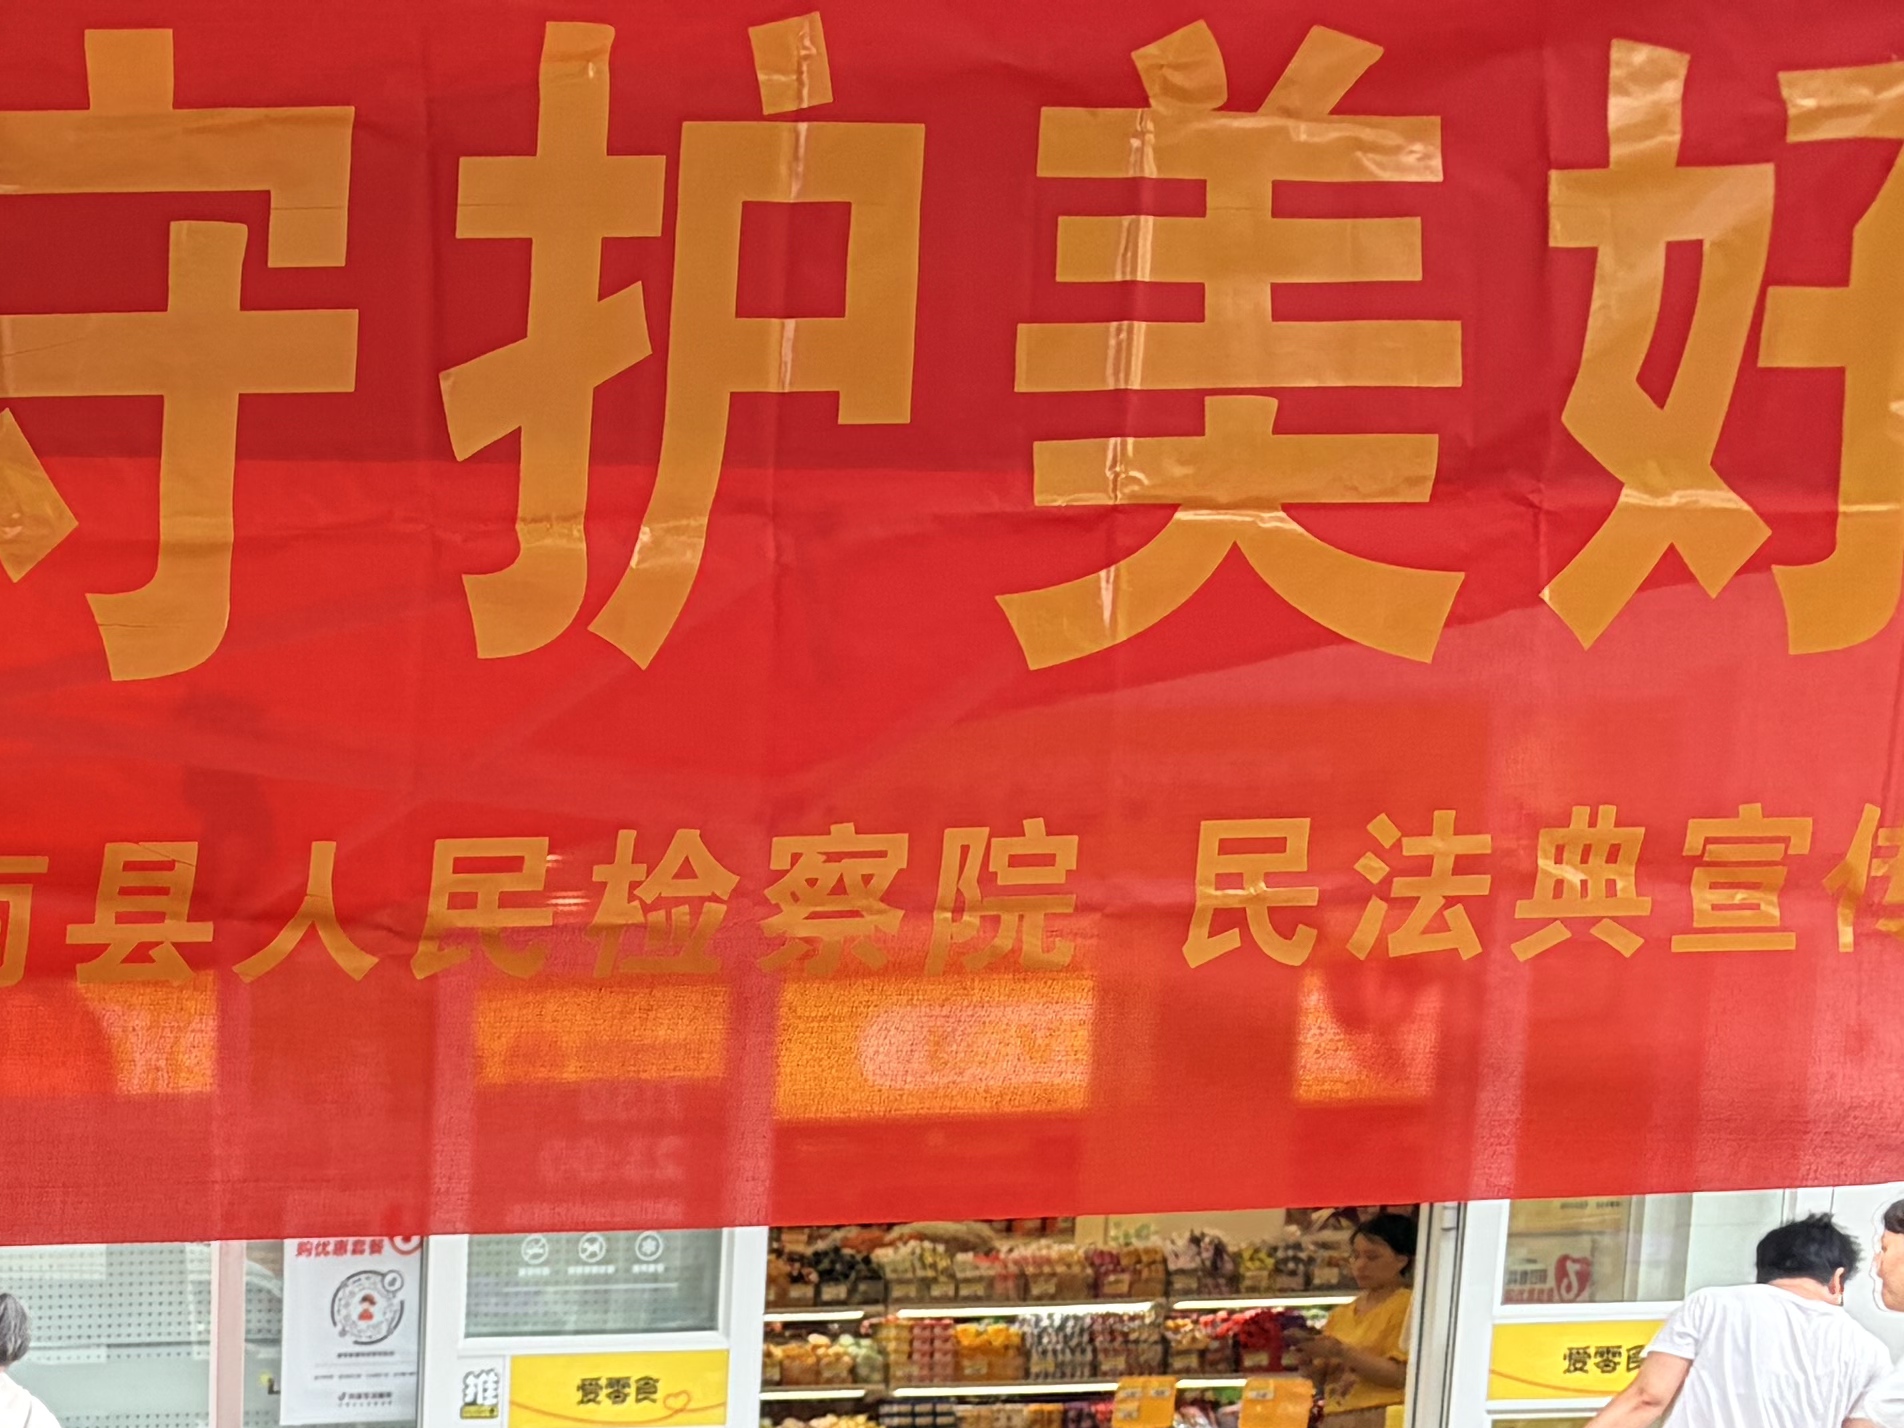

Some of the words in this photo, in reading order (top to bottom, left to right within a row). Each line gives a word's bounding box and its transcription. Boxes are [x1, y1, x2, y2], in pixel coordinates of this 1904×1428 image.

[296, 1239, 385, 1257] 购优惠套餐
[462, 1368, 500, 1405] 推
[575, 1375, 660, 1406] 爱零食
